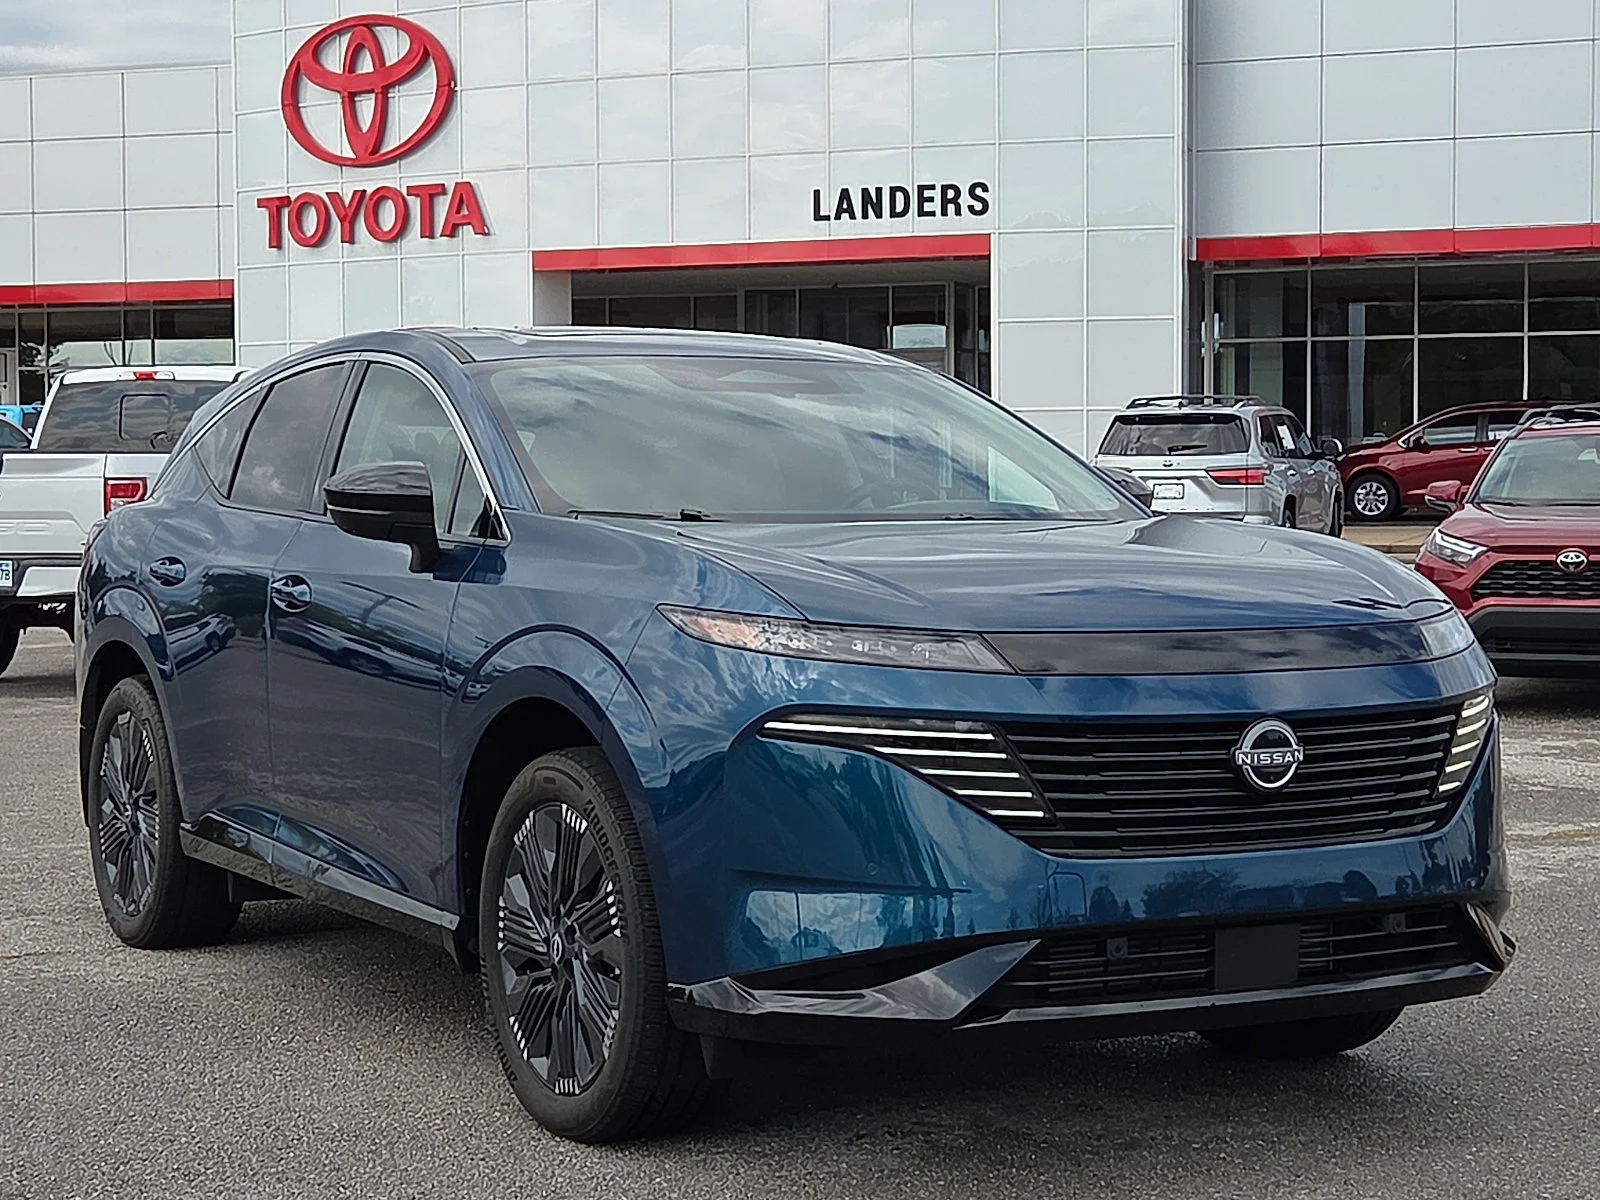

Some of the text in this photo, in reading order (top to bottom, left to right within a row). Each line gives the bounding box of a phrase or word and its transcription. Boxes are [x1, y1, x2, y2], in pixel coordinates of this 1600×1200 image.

[257, 181, 489, 249] TOYOTA
[813, 182, 990, 221] LANDERS
[1238, 751, 1304, 765] NISSAN
